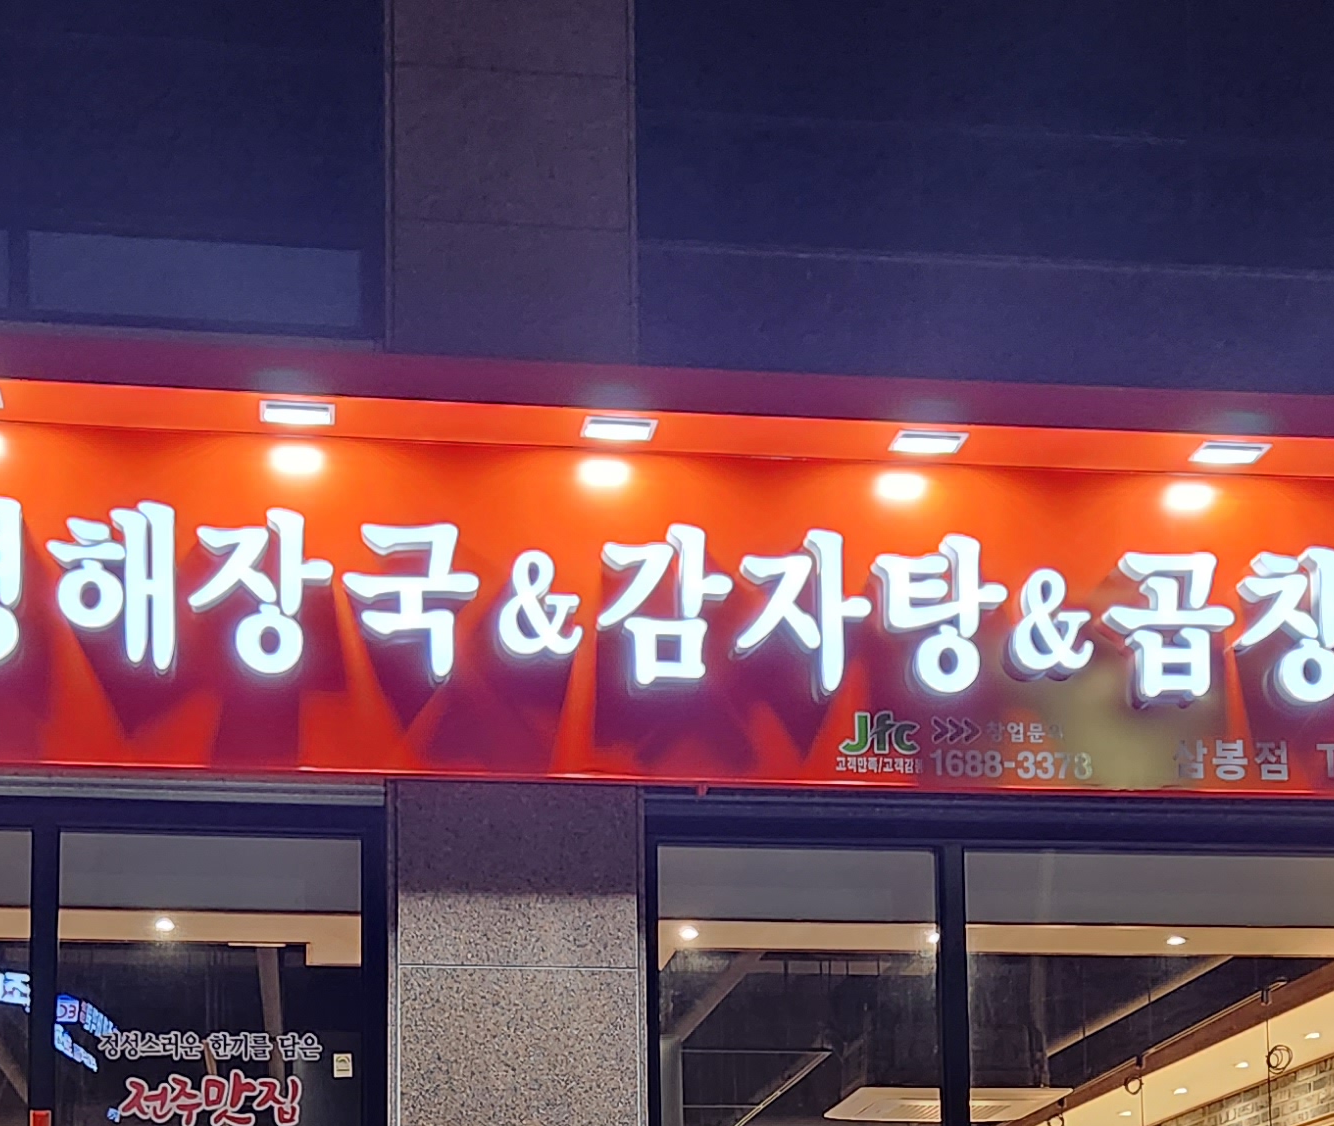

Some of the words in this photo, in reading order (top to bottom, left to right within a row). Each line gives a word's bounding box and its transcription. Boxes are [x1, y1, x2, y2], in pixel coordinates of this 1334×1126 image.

[1173, 738, 1290, 782] 삼봉점
[98, 1031, 203, 1060] 정성스러운
[207, 1032, 273, 1062] 한끼를
[276, 1033, 323, 1062] 담은
